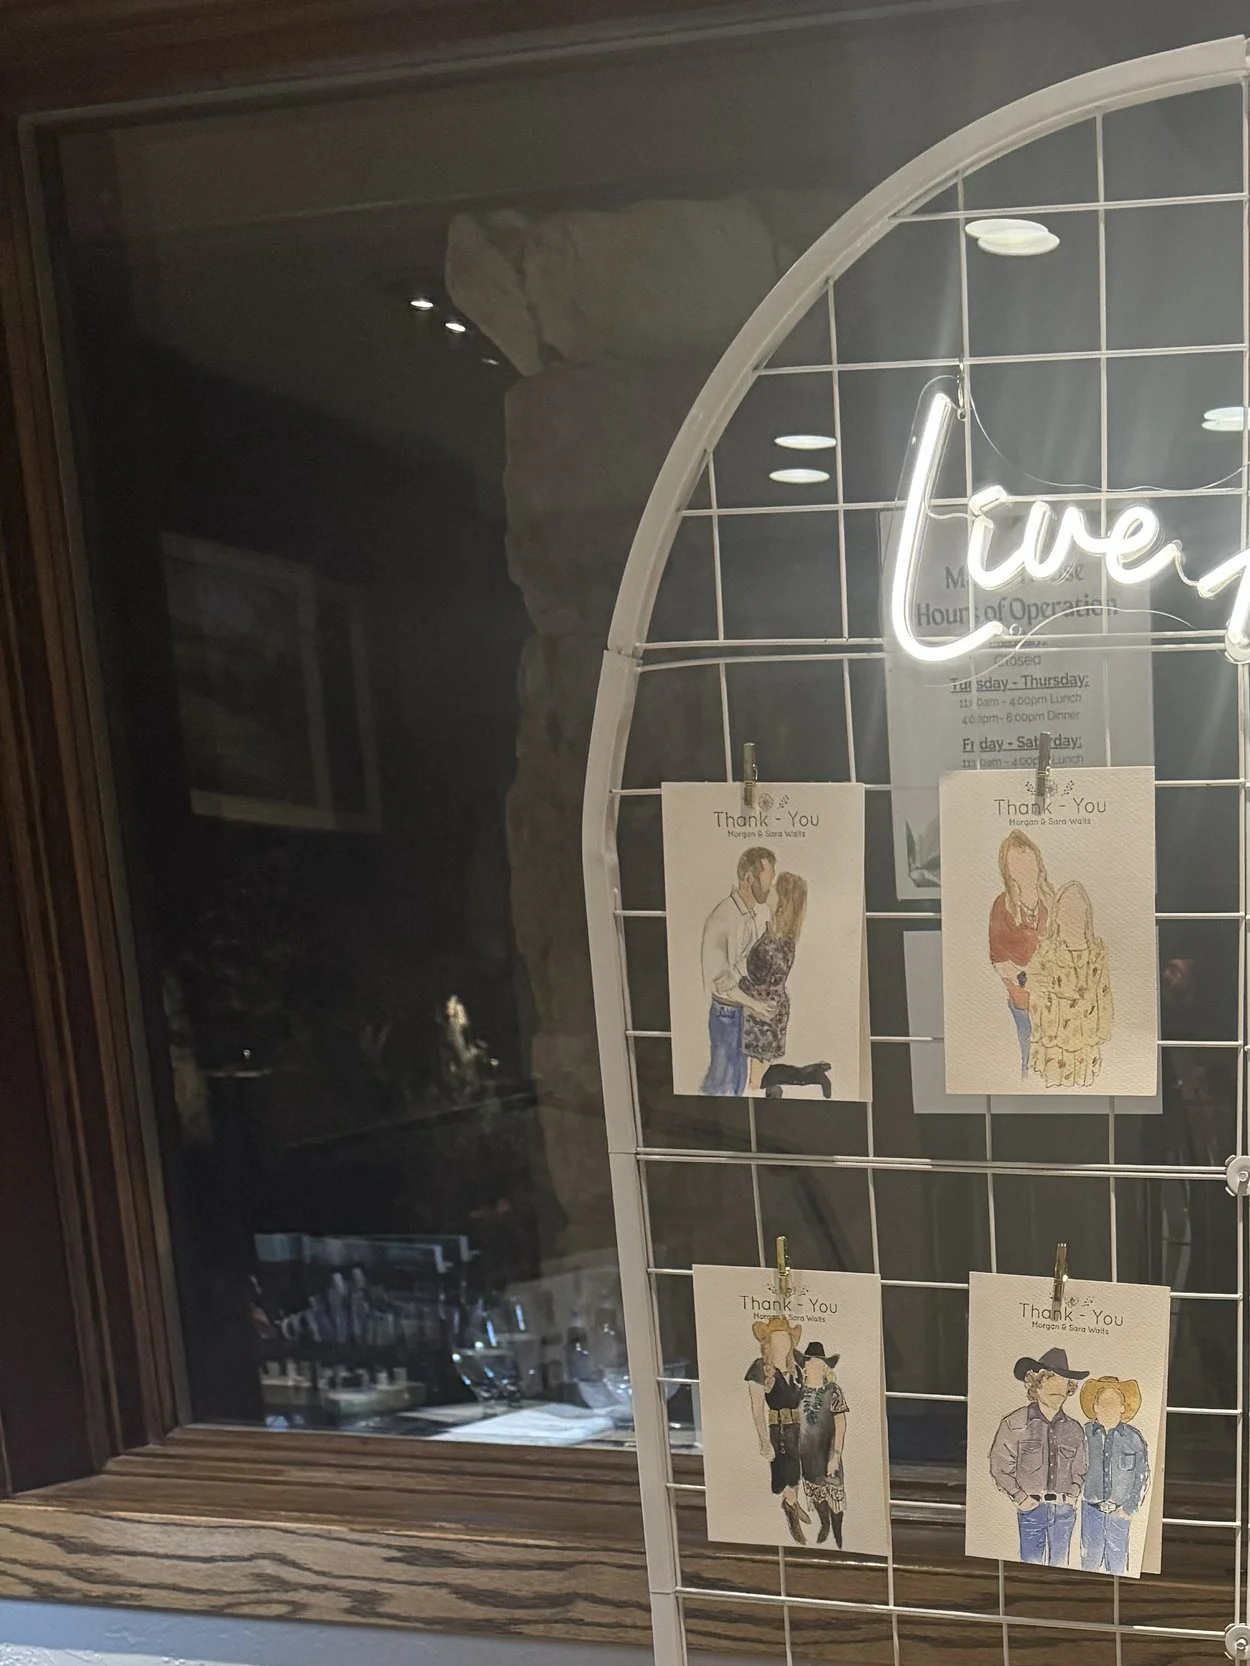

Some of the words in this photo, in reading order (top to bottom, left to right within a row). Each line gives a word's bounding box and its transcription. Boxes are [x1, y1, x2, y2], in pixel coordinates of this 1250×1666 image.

[890, 391, 1180, 662] Live
[985, 597, 1008, 622] of
[1009, 593, 1118, 626] Operation
[1021, 673, 1090, 691] Thursday:
[1050, 693, 1082, 705] Lunch
[994, 797, 1053, 816] Thank
[1073, 797, 1107, 814] You
[713, 811, 768, 828] Thank
[788, 810, 820, 828] You
[1009, 818, 1039, 827] Morgan
[1048, 817, 1067, 825] Sara
[728, 830, 756, 839] Morgan
[765, 830, 783, 838] Sara
[739, 1295, 792, 1312] Thank
[809, 1298, 838, 1314] You
[788, 1314, 805, 1322] Sara
[1019, 1302, 1073, 1322] Thank
[1092, 1309, 1124, 1327] You
[1032, 1320, 1060, 1331] Morgan
[1069, 1323, 1086, 1333] Sara
